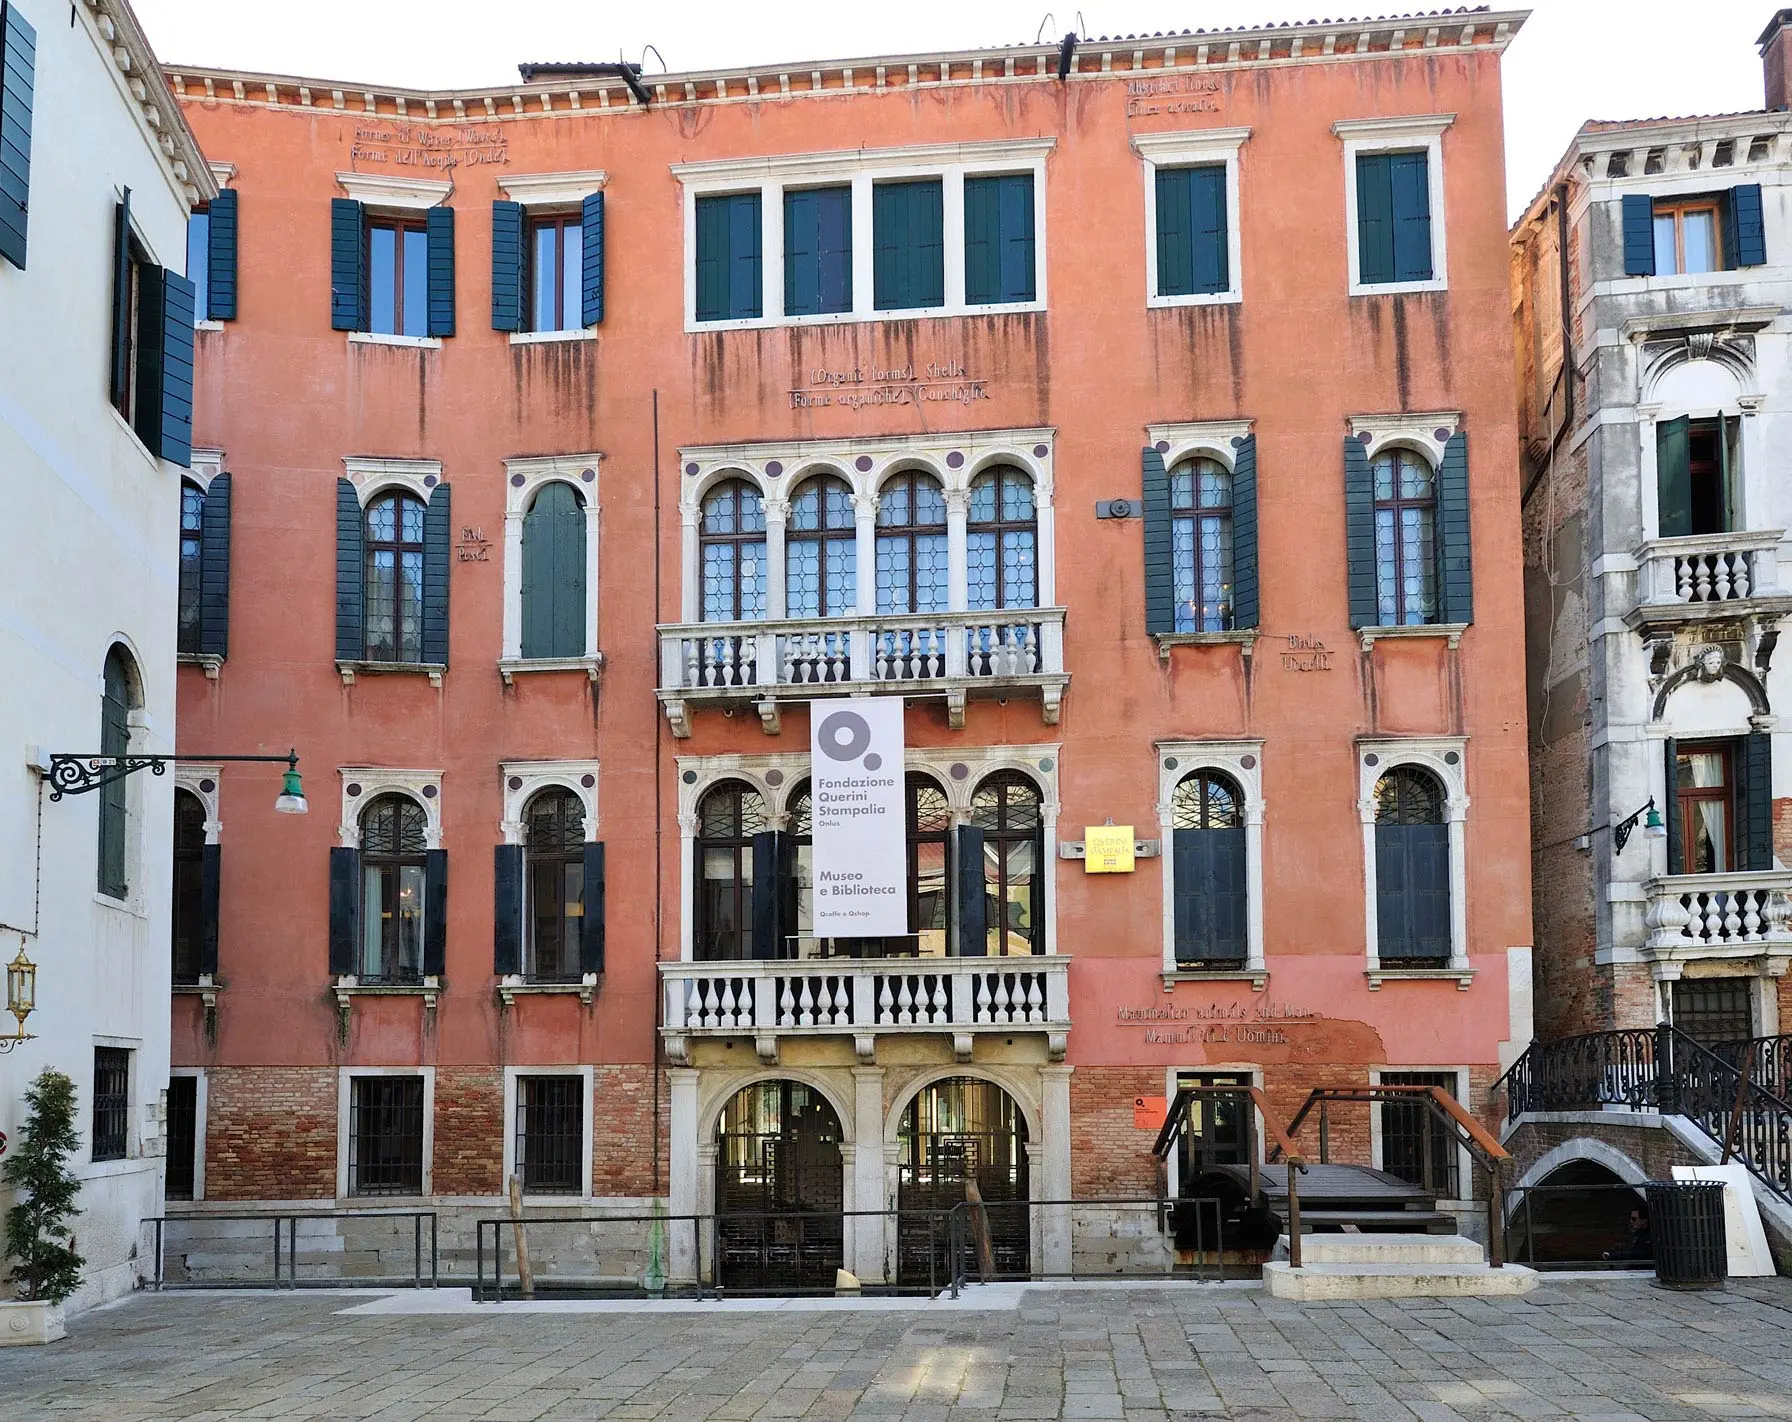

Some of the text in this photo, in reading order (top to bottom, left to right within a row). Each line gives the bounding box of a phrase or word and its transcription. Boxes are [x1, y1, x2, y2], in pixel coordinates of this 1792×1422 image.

[818, 776, 895, 789] Fondazione
[818, 789, 868, 803] Querini
[819, 803, 886, 818] Stampalia
[818, 819, 840, 827] Onlus
[819, 870, 863, 881] Museo
[819, 883, 896, 896] e Biblioteca
